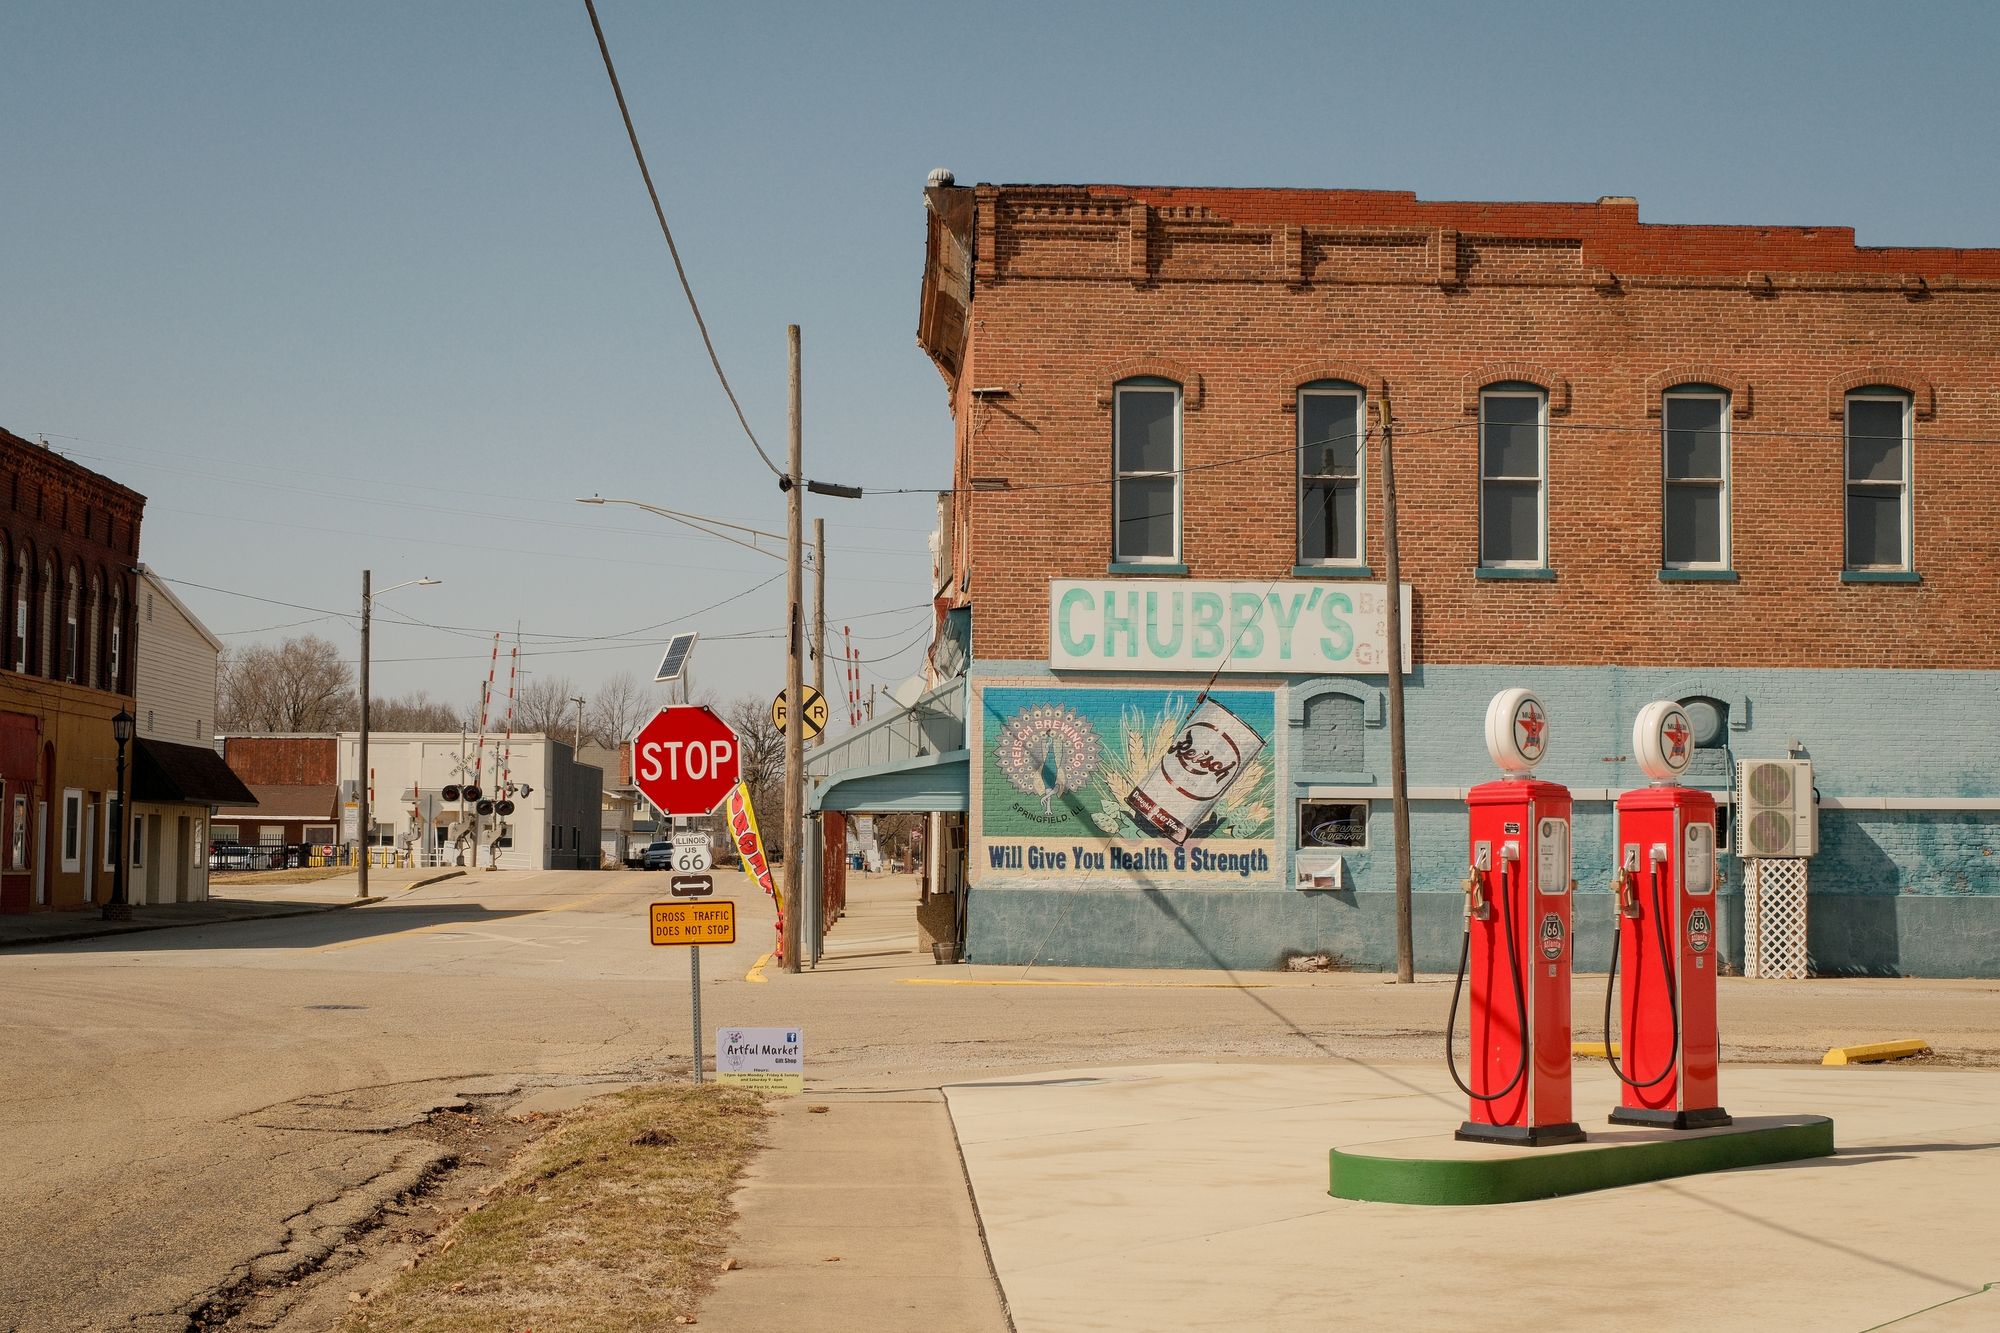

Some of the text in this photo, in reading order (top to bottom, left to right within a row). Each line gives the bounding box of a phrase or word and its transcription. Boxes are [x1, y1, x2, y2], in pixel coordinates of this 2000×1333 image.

[1058, 587, 1354, 661] CHUBBY'S
[777, 706, 824, 719] R R
[1012, 725, 1034, 767] REISCH
[1034, 720, 1084, 750] BREWING
[641, 740, 732, 781] STOP
[1167, 730, 1236, 784] Reisch
[675, 836, 706, 845] ILLINOIS
[1317, 831, 1365, 841] LIGHT
[679, 854, 704, 871] 66
[988, 845, 1269, 878] Will Give You Health & Strength
[655, 910, 729, 922] CROSS TRAFFIC
[656, 924, 730, 936] DOES NOT STOP
[1547, 923, 1559, 936] 66
[1694, 918, 1705, 930] 66
[727, 1044, 799, 1056] Artful Market
